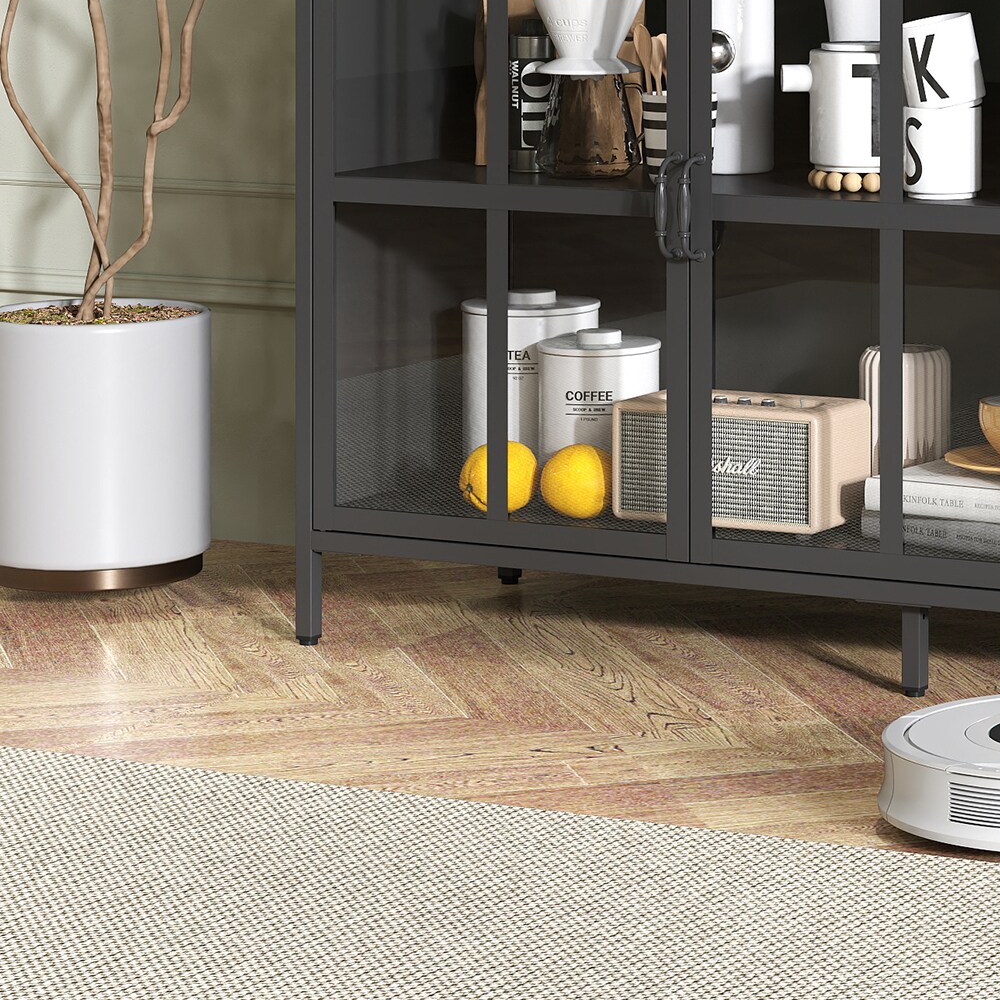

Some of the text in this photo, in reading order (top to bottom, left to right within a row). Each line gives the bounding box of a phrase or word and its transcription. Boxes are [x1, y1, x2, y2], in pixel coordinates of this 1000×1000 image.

[908, 34, 950, 103] K
[511, 60, 519, 109] WALNUT
[508, 350, 531, 361] TEA
[565, 390, 613, 401] COFFEE
[712, 456, 761, 475] shall
[904, 495, 938, 506] KINFOLK
[940, 498, 964, 508] TABLE
